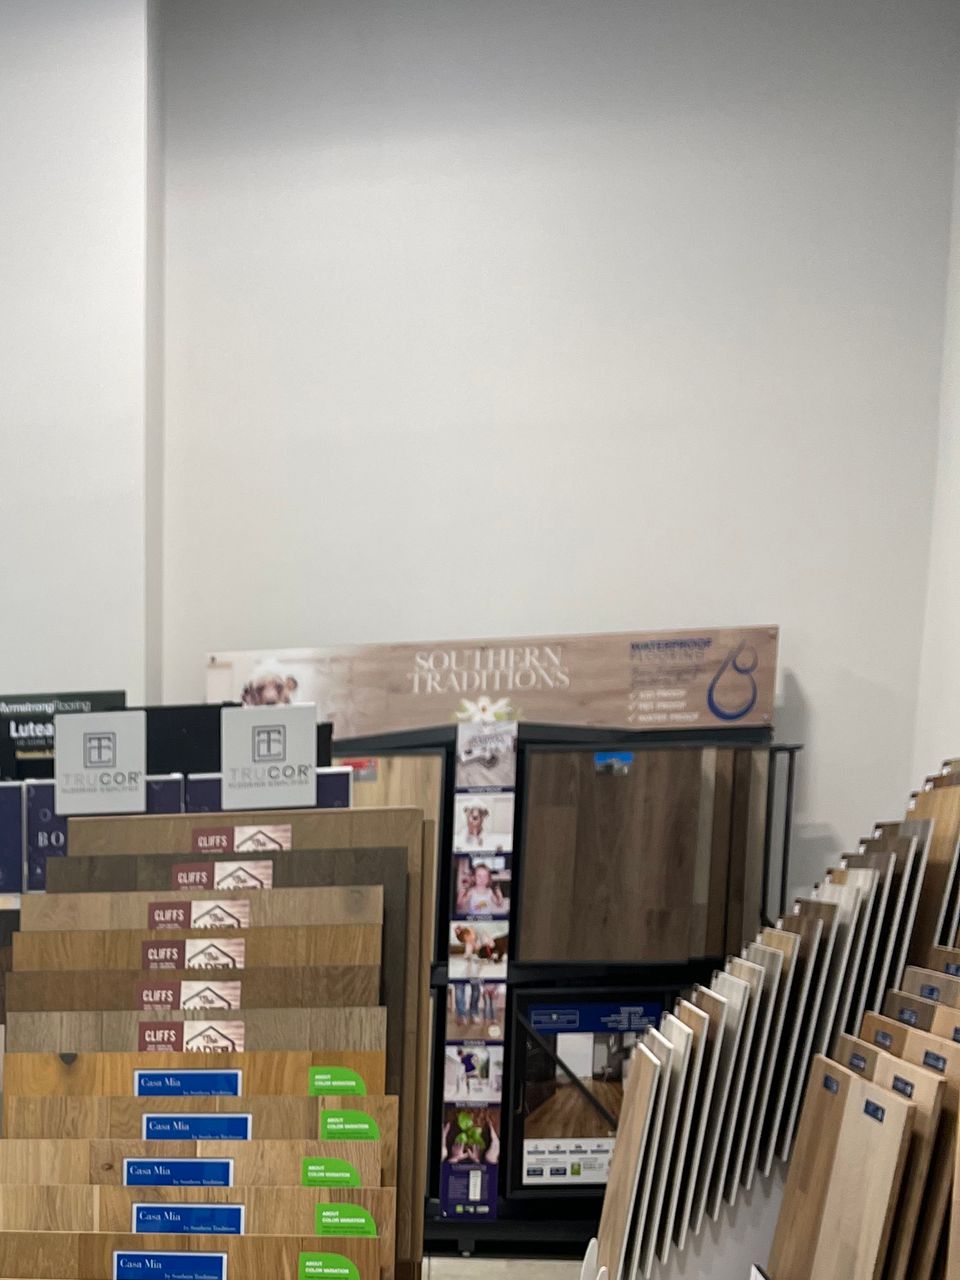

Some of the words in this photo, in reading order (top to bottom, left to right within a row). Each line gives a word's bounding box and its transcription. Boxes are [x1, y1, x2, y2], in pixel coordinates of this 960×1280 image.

[415, 646, 562, 671] SOUTHERN
[406, 667, 570, 694] TRADITIONS
[198, 836, 227, 847] CLIFFS
[178, 872, 207, 883] CLIFFS
[154, 910, 184, 921] CLIFFS
[147, 948, 178, 960] CLIFFS
[143, 990, 173, 1002] CLIFFS
[145, 1030, 176, 1042] CLIFFS
[141, 1077, 163, 1087] Casa
[164, 1077, 181, 1087] Mia
[149, 1121, 170, 1131] Casa
[172, 1121, 190, 1131] Mia
[129, 1165, 151, 1175] Casa
[153, 1165, 171, 1175] Mia
[139, 1211, 161, 1221] Casa
[163, 1211, 181, 1221] Mia
[120, 1258, 142, 1269] Casa
[144, 1259, 162, 1269] Mia
